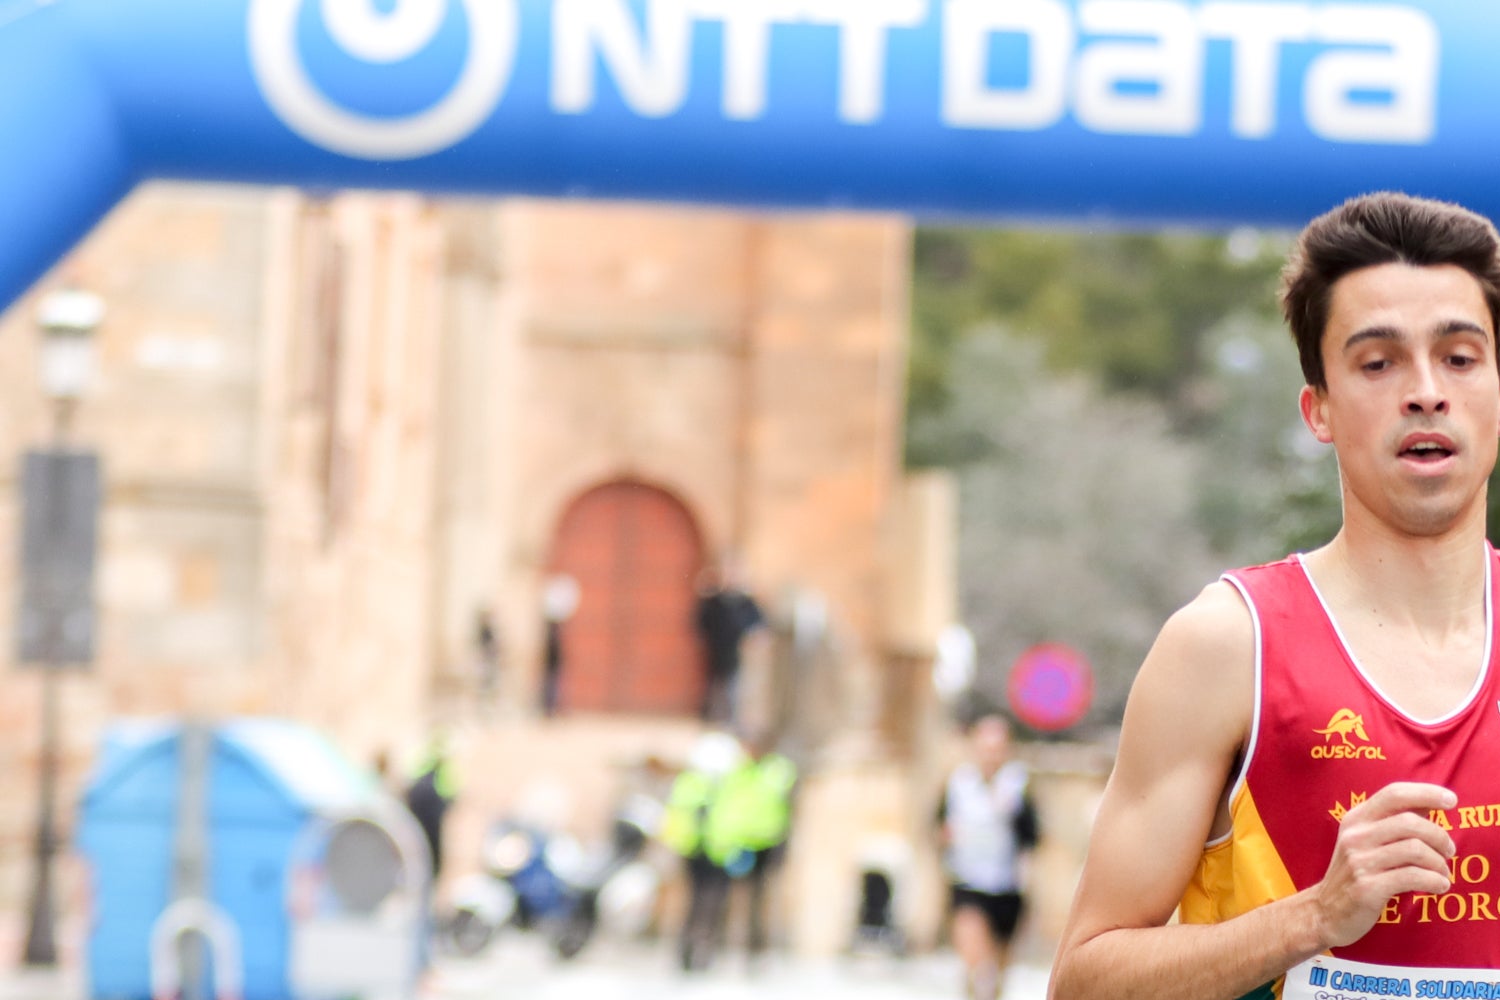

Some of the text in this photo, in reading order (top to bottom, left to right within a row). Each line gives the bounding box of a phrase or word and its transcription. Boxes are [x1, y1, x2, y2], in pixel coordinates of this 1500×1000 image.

[549, 0, 929, 125] NTT
[1310, 745, 1387, 760] austral
[1376, 895, 1401, 923] E
[1309, 966, 1328, 987] III
[1330, 970, 1411, 997] CARRERA
